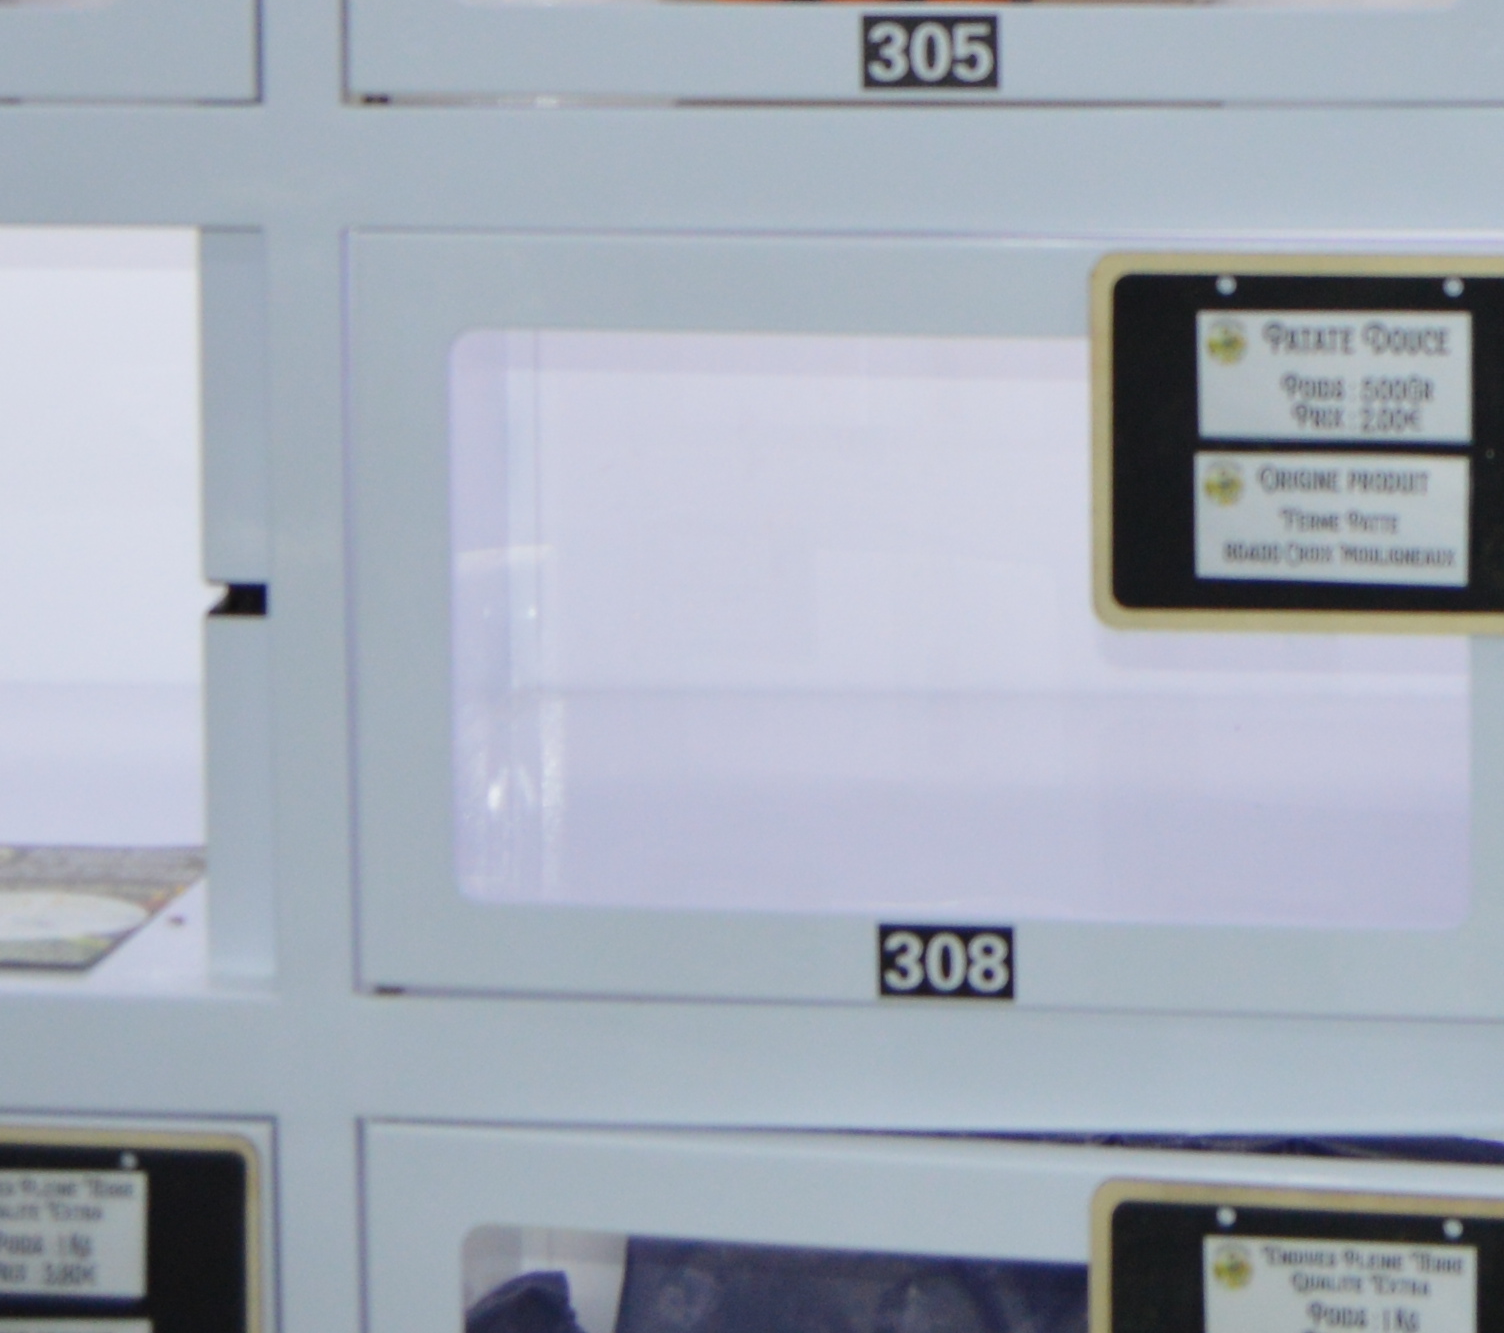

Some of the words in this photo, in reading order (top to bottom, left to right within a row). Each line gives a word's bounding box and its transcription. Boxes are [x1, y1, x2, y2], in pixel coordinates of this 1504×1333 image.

[867, 22, 994, 82] 305
[1361, 320, 1449, 356] DOUCE
[883, 931, 1009, 993] 308
